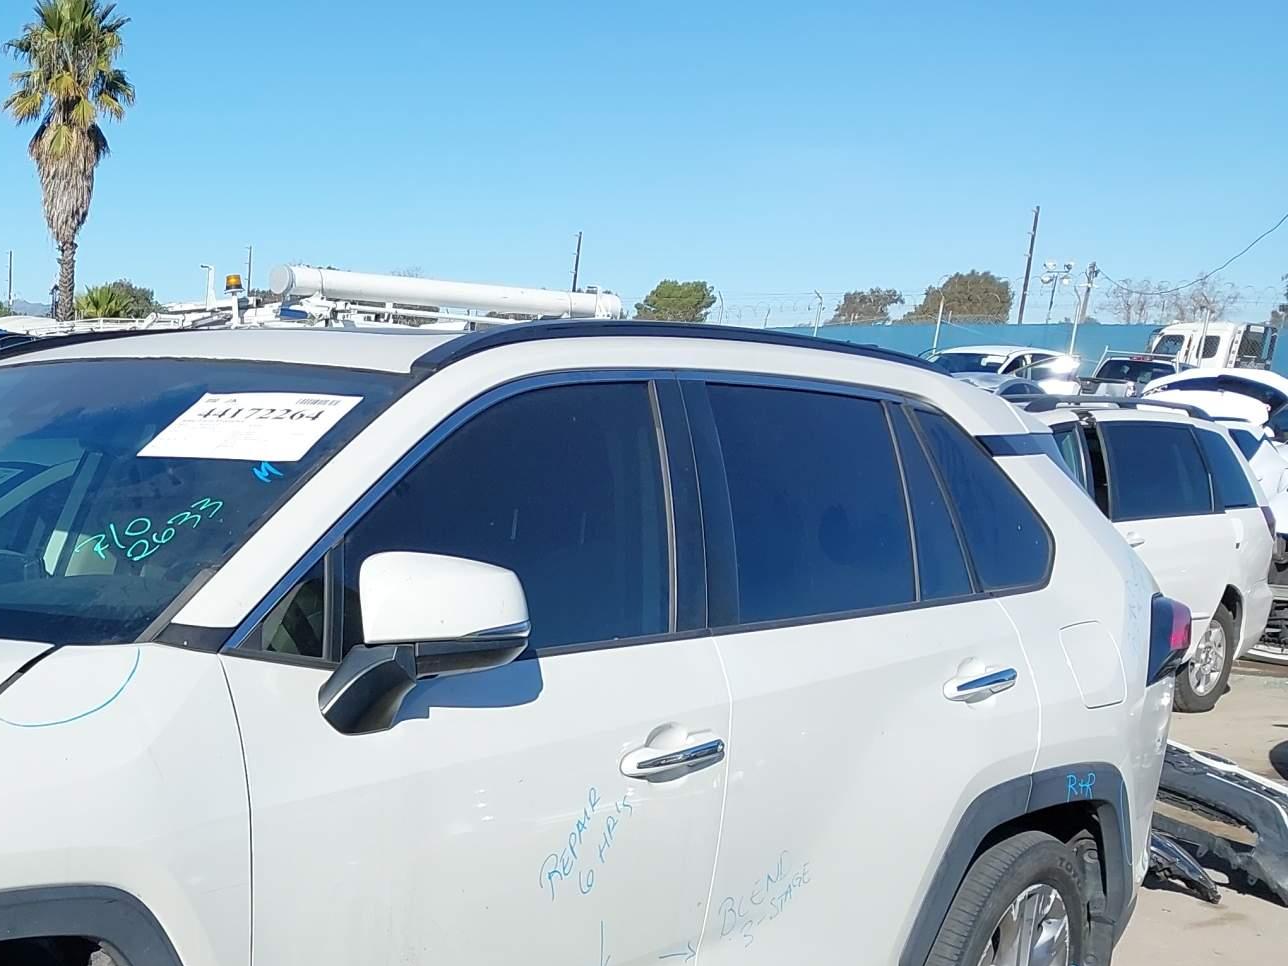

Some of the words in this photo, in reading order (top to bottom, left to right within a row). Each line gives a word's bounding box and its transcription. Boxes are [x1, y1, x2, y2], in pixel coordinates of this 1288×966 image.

[198, 407, 324, 421] 44172264
[126, 498, 223, 561] 2633
[1066, 773, 1096, 803] R+R
[539, 787, 601, 902] REPAIR
